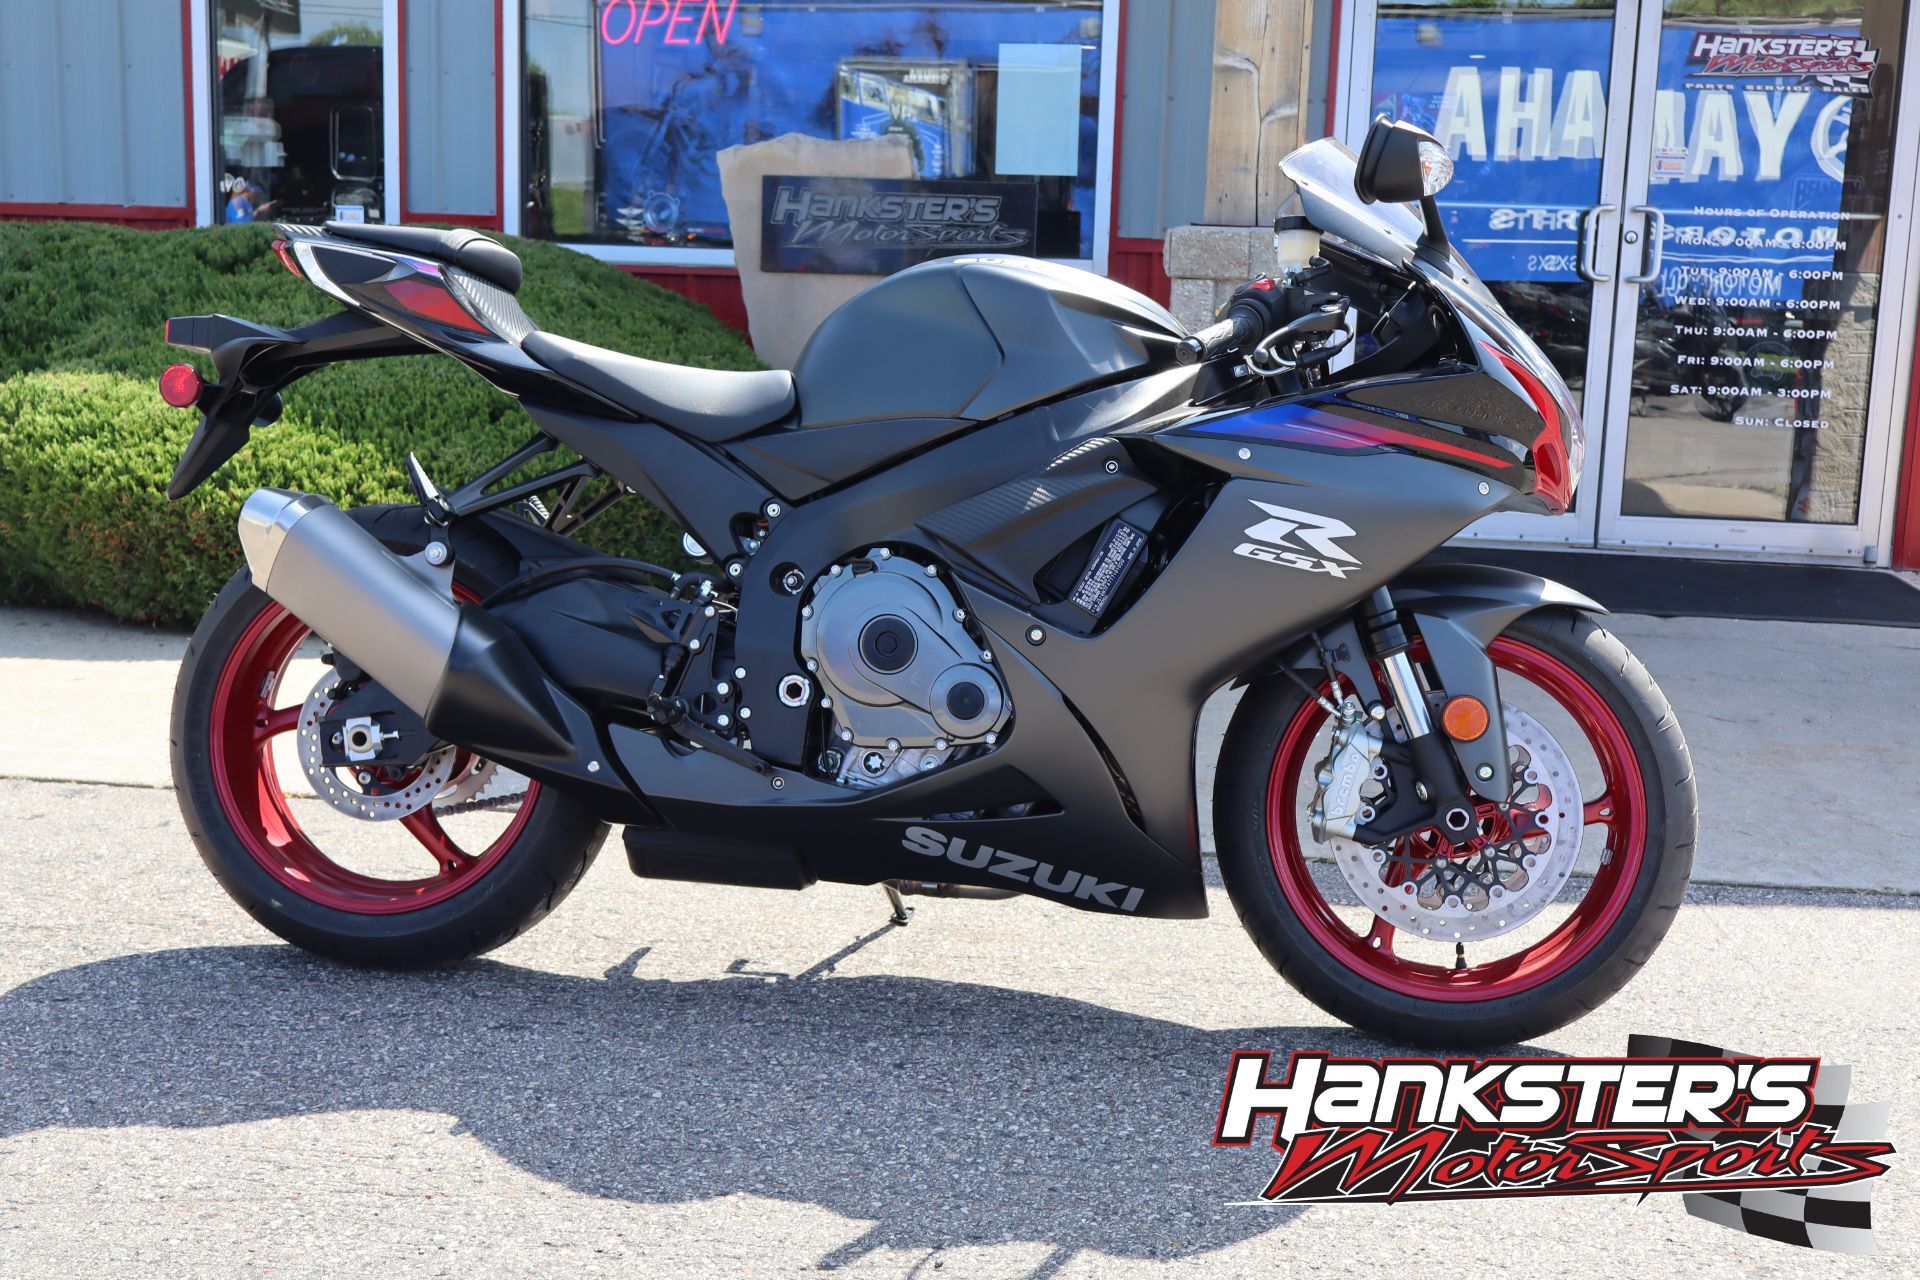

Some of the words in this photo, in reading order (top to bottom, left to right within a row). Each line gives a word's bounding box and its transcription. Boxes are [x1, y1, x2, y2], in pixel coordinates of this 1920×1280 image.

[601, 0, 737, 45] OPEN
[1685, 83, 1736, 91] PARTS
[1745, 84, 1812, 93] SERVICE
[1822, 86, 1871, 94] SALES
[1694, 206, 1741, 217] HOURS
[1747, 208, 1765, 218] OF
[1769, 208, 1850, 220] OPERATION
[1791, 239, 1847, 251] 6:00PM
[1681, 266, 1714, 276] TUE:
[1719, 267, 1774, 278] 9:00AM
[1789, 269, 1844, 280] 6:00PM
[1674, 296, 1710, 306] WED:
[1715, 297, 1770, 308] 9:00AM
[1786, 299, 1841, 310] 6:00PM
[1675, 325, 1707, 336] THU:
[1713, 326, 1768, 338] 9:00AM
[1783, 328, 1838, 340] 6:00PM
[1677, 355, 1705, 365] FRI:
[1710, 356, 1765, 368] 9:00AM
[1780, 358, 1835, 369] 6:00PM
[1670, 384, 1702, 395] SAT:
[1707, 386, 1762, 397] 9:00AM
[1777, 388, 1832, 399] 3:00PM
[1735, 416, 1768, 426] SUN:
[1774, 417, 1829, 429] CLOSED
[1330, 753, 1360, 816] brembo
[901, 826, 1144, 912] SUZUKI
